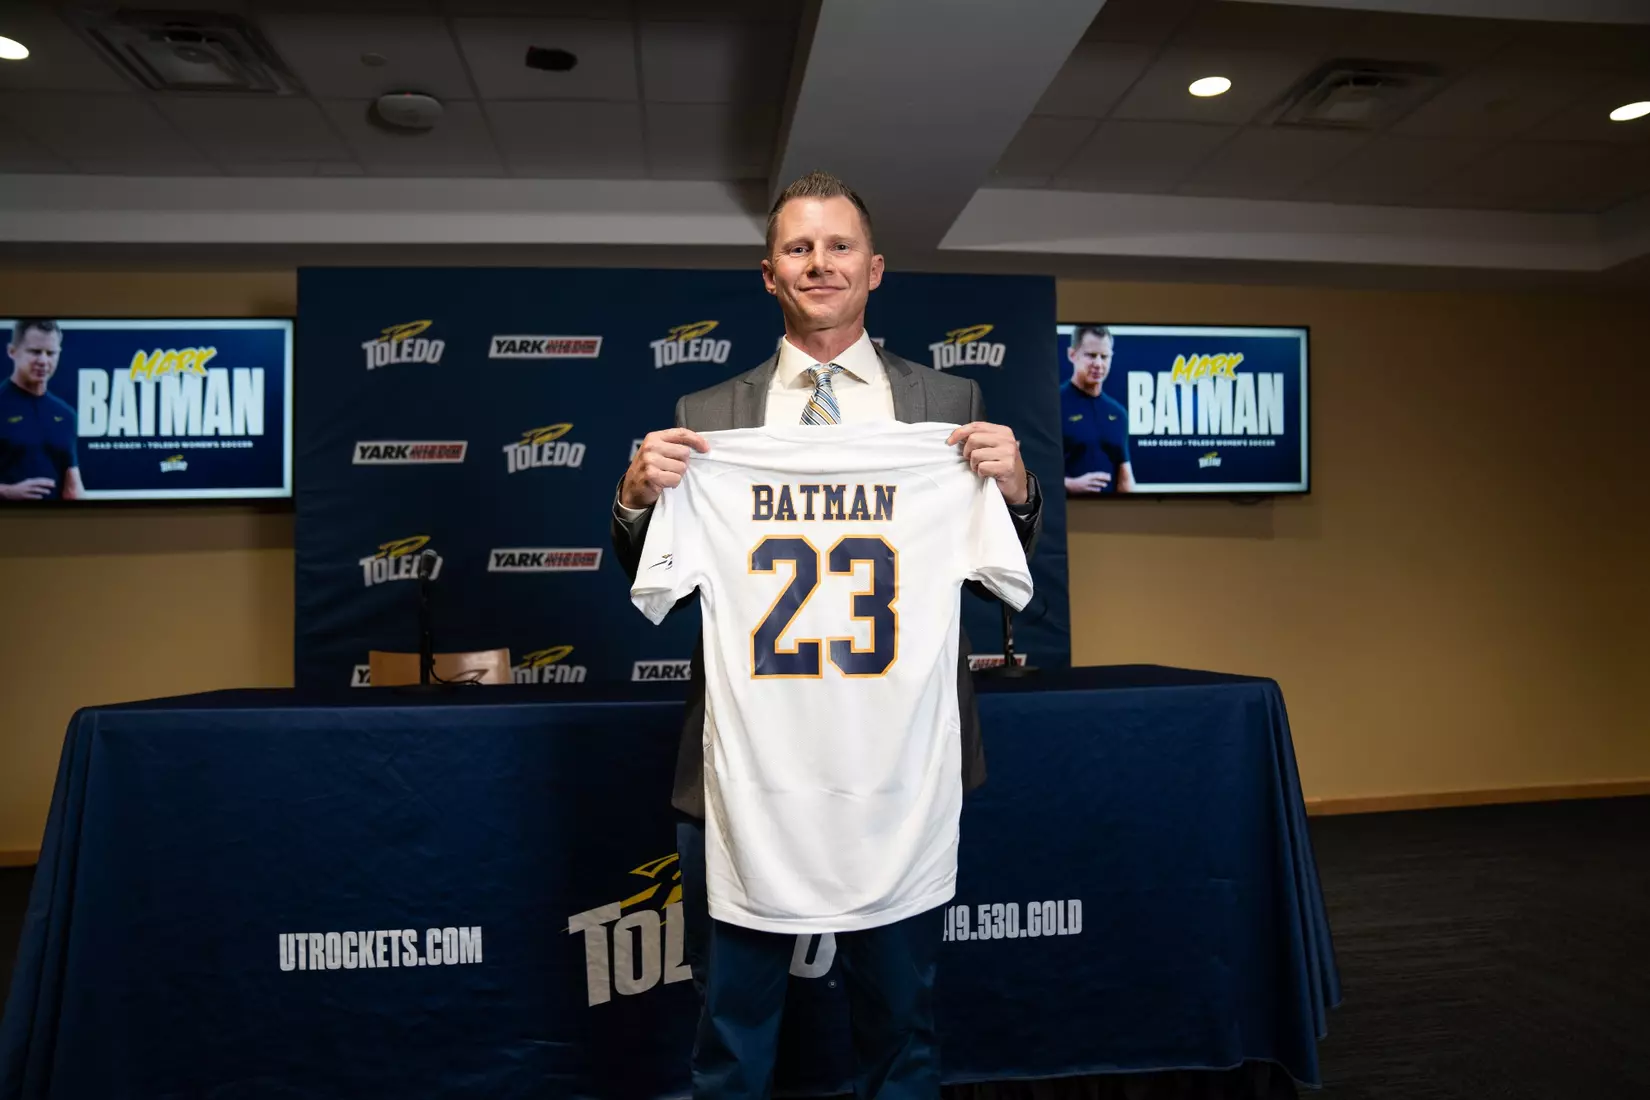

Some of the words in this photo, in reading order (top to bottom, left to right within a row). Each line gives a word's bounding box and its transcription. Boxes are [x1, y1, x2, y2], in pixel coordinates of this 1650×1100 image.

[361, 338, 445, 370] TOLEDO
[495, 340, 545, 354] YARK
[650, 338, 732, 369] TOLEDO
[928, 341, 1006, 370] TOLEDO
[129, 346, 217, 381] MARK
[1171, 352, 1244, 384] MARK
[77, 368, 264, 437] BATMAN
[1127, 371, 1284, 435] BATMAN
[359, 445, 410, 459] YARK
[502, 441, 586, 474] TOLEDO
[750, 484, 897, 522] BATMAN
[494, 552, 545, 567] YARK
[748, 534, 899, 679] 23
[637, 664, 688, 680] YARK
[943, 899, 1082, 941] 19.530.GOLD
[279, 926, 483, 971] UTROCKETS.COM
